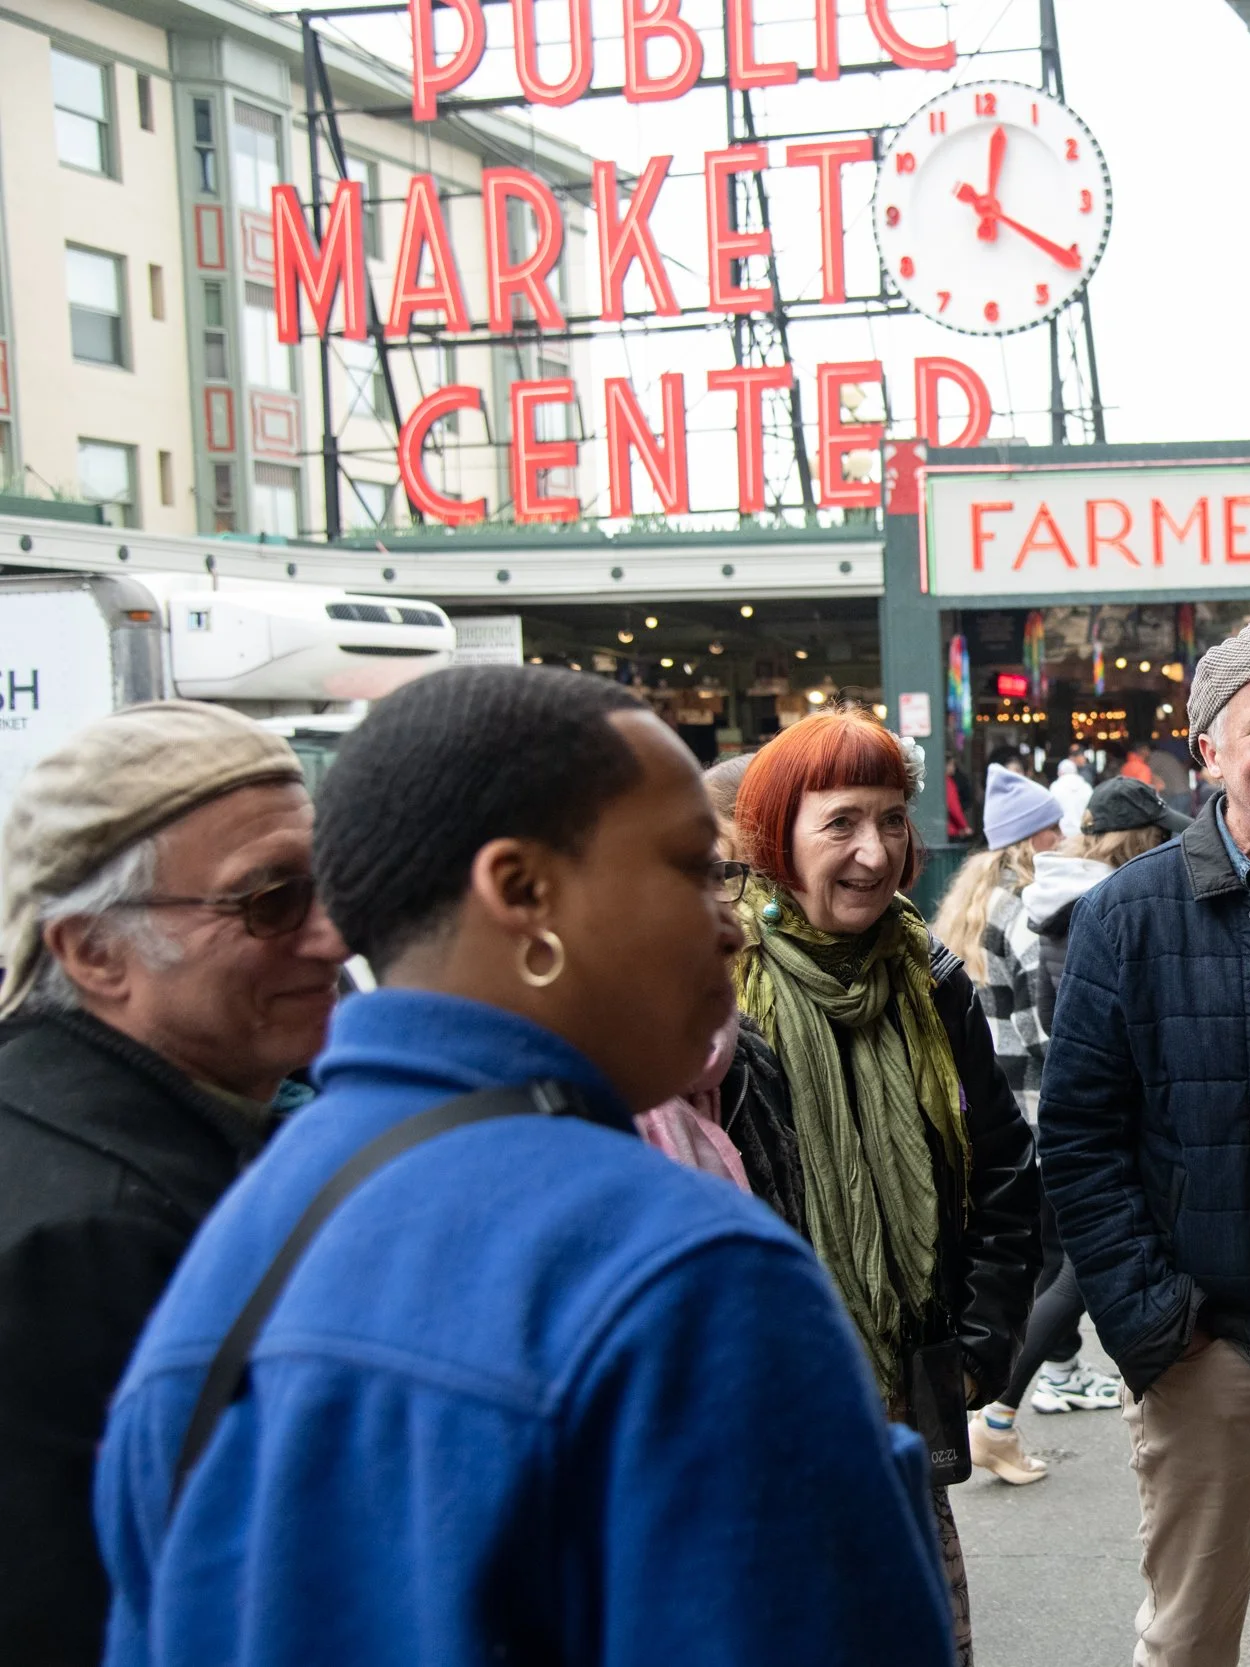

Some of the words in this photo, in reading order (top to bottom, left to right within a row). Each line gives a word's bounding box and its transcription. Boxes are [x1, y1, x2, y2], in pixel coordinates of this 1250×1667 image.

[974, 92, 997, 116] 12
[1031, 103, 1039, 126] 1
[929, 111, 946, 136] 11
[1065, 138, 1079, 161] 2
[896, 152, 916, 175] 10
[1079, 189, 1092, 214] 3
[886, 205, 900, 227] 9
[272, 139, 874, 344] MARKET
[899, 256, 915, 279] 8
[936, 290, 951, 313] 7
[1035, 283, 1049, 306] 5
[983, 301, 999, 323] 6
[0, 669, 39, 711] H
